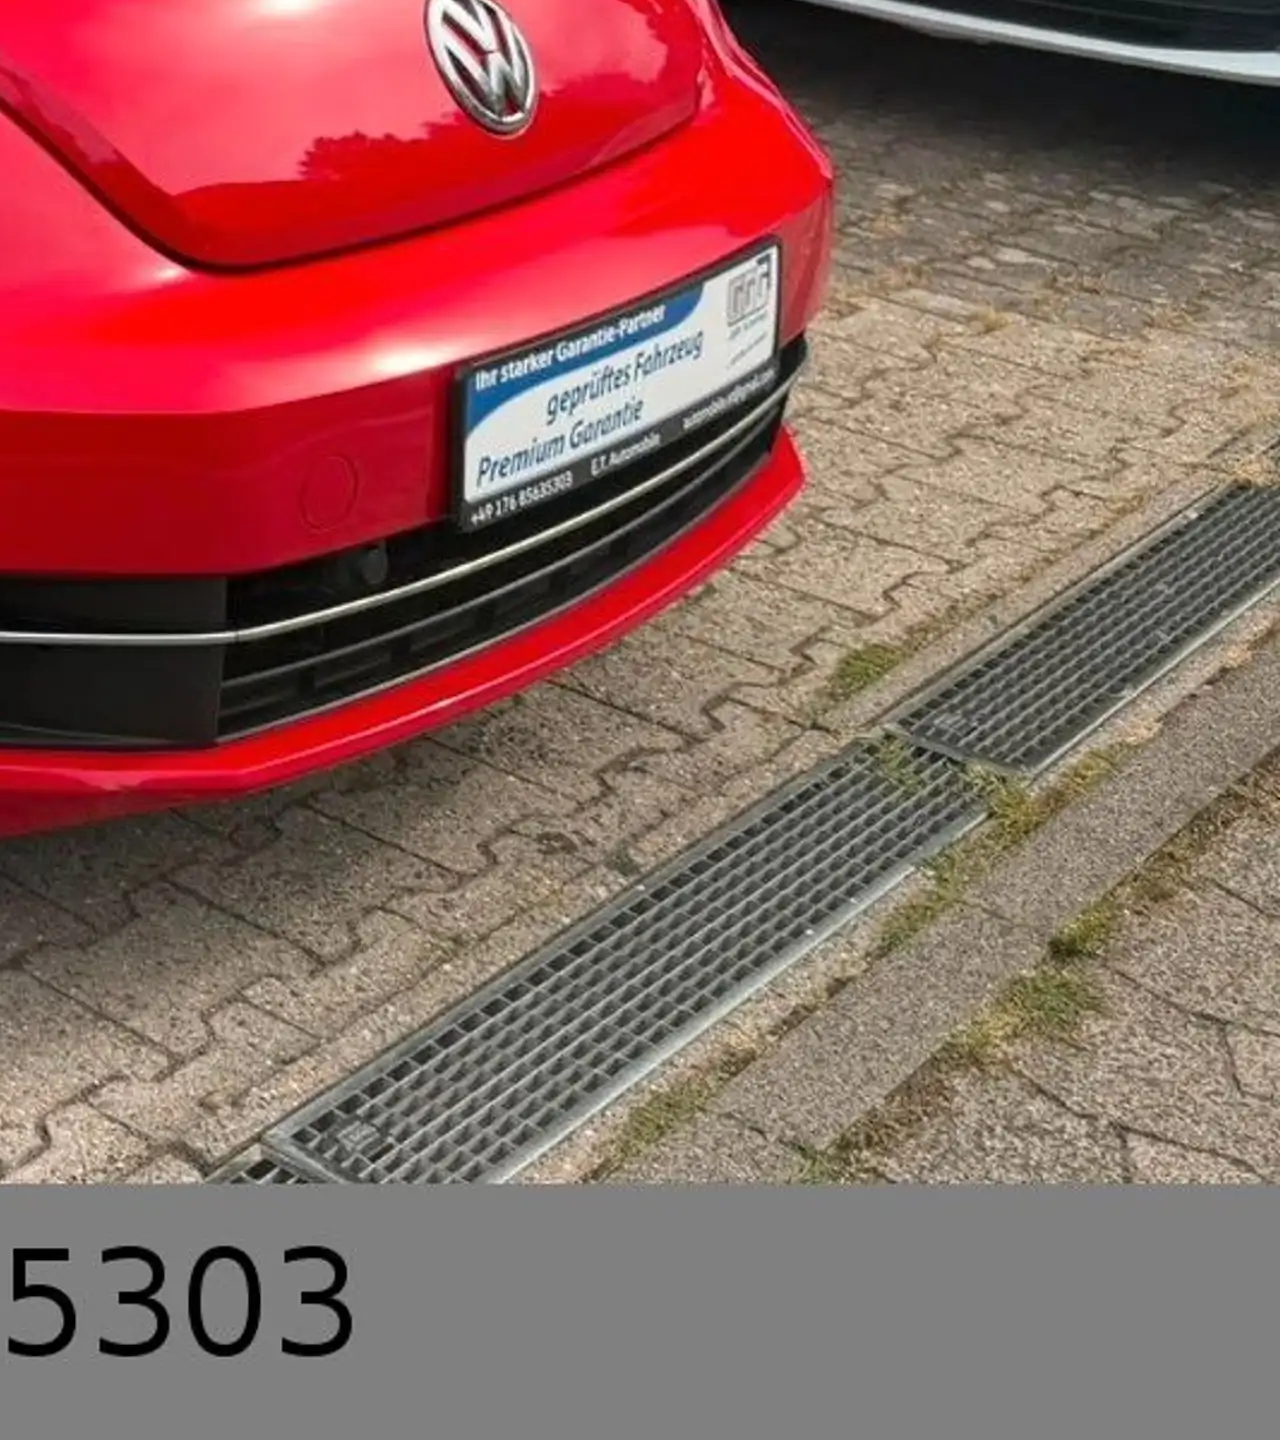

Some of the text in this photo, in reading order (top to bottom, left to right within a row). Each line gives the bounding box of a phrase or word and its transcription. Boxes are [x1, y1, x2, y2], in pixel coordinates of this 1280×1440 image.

[475, 305, 667, 392] Ihr starker Garantie-Partner
[546, 362, 631, 426] geprüftes
[633, 330, 704, 381] Fahrzeug
[476, 395, 644, 488] Premium Garantie
[470, 470, 574, 526] +49 176 85635303
